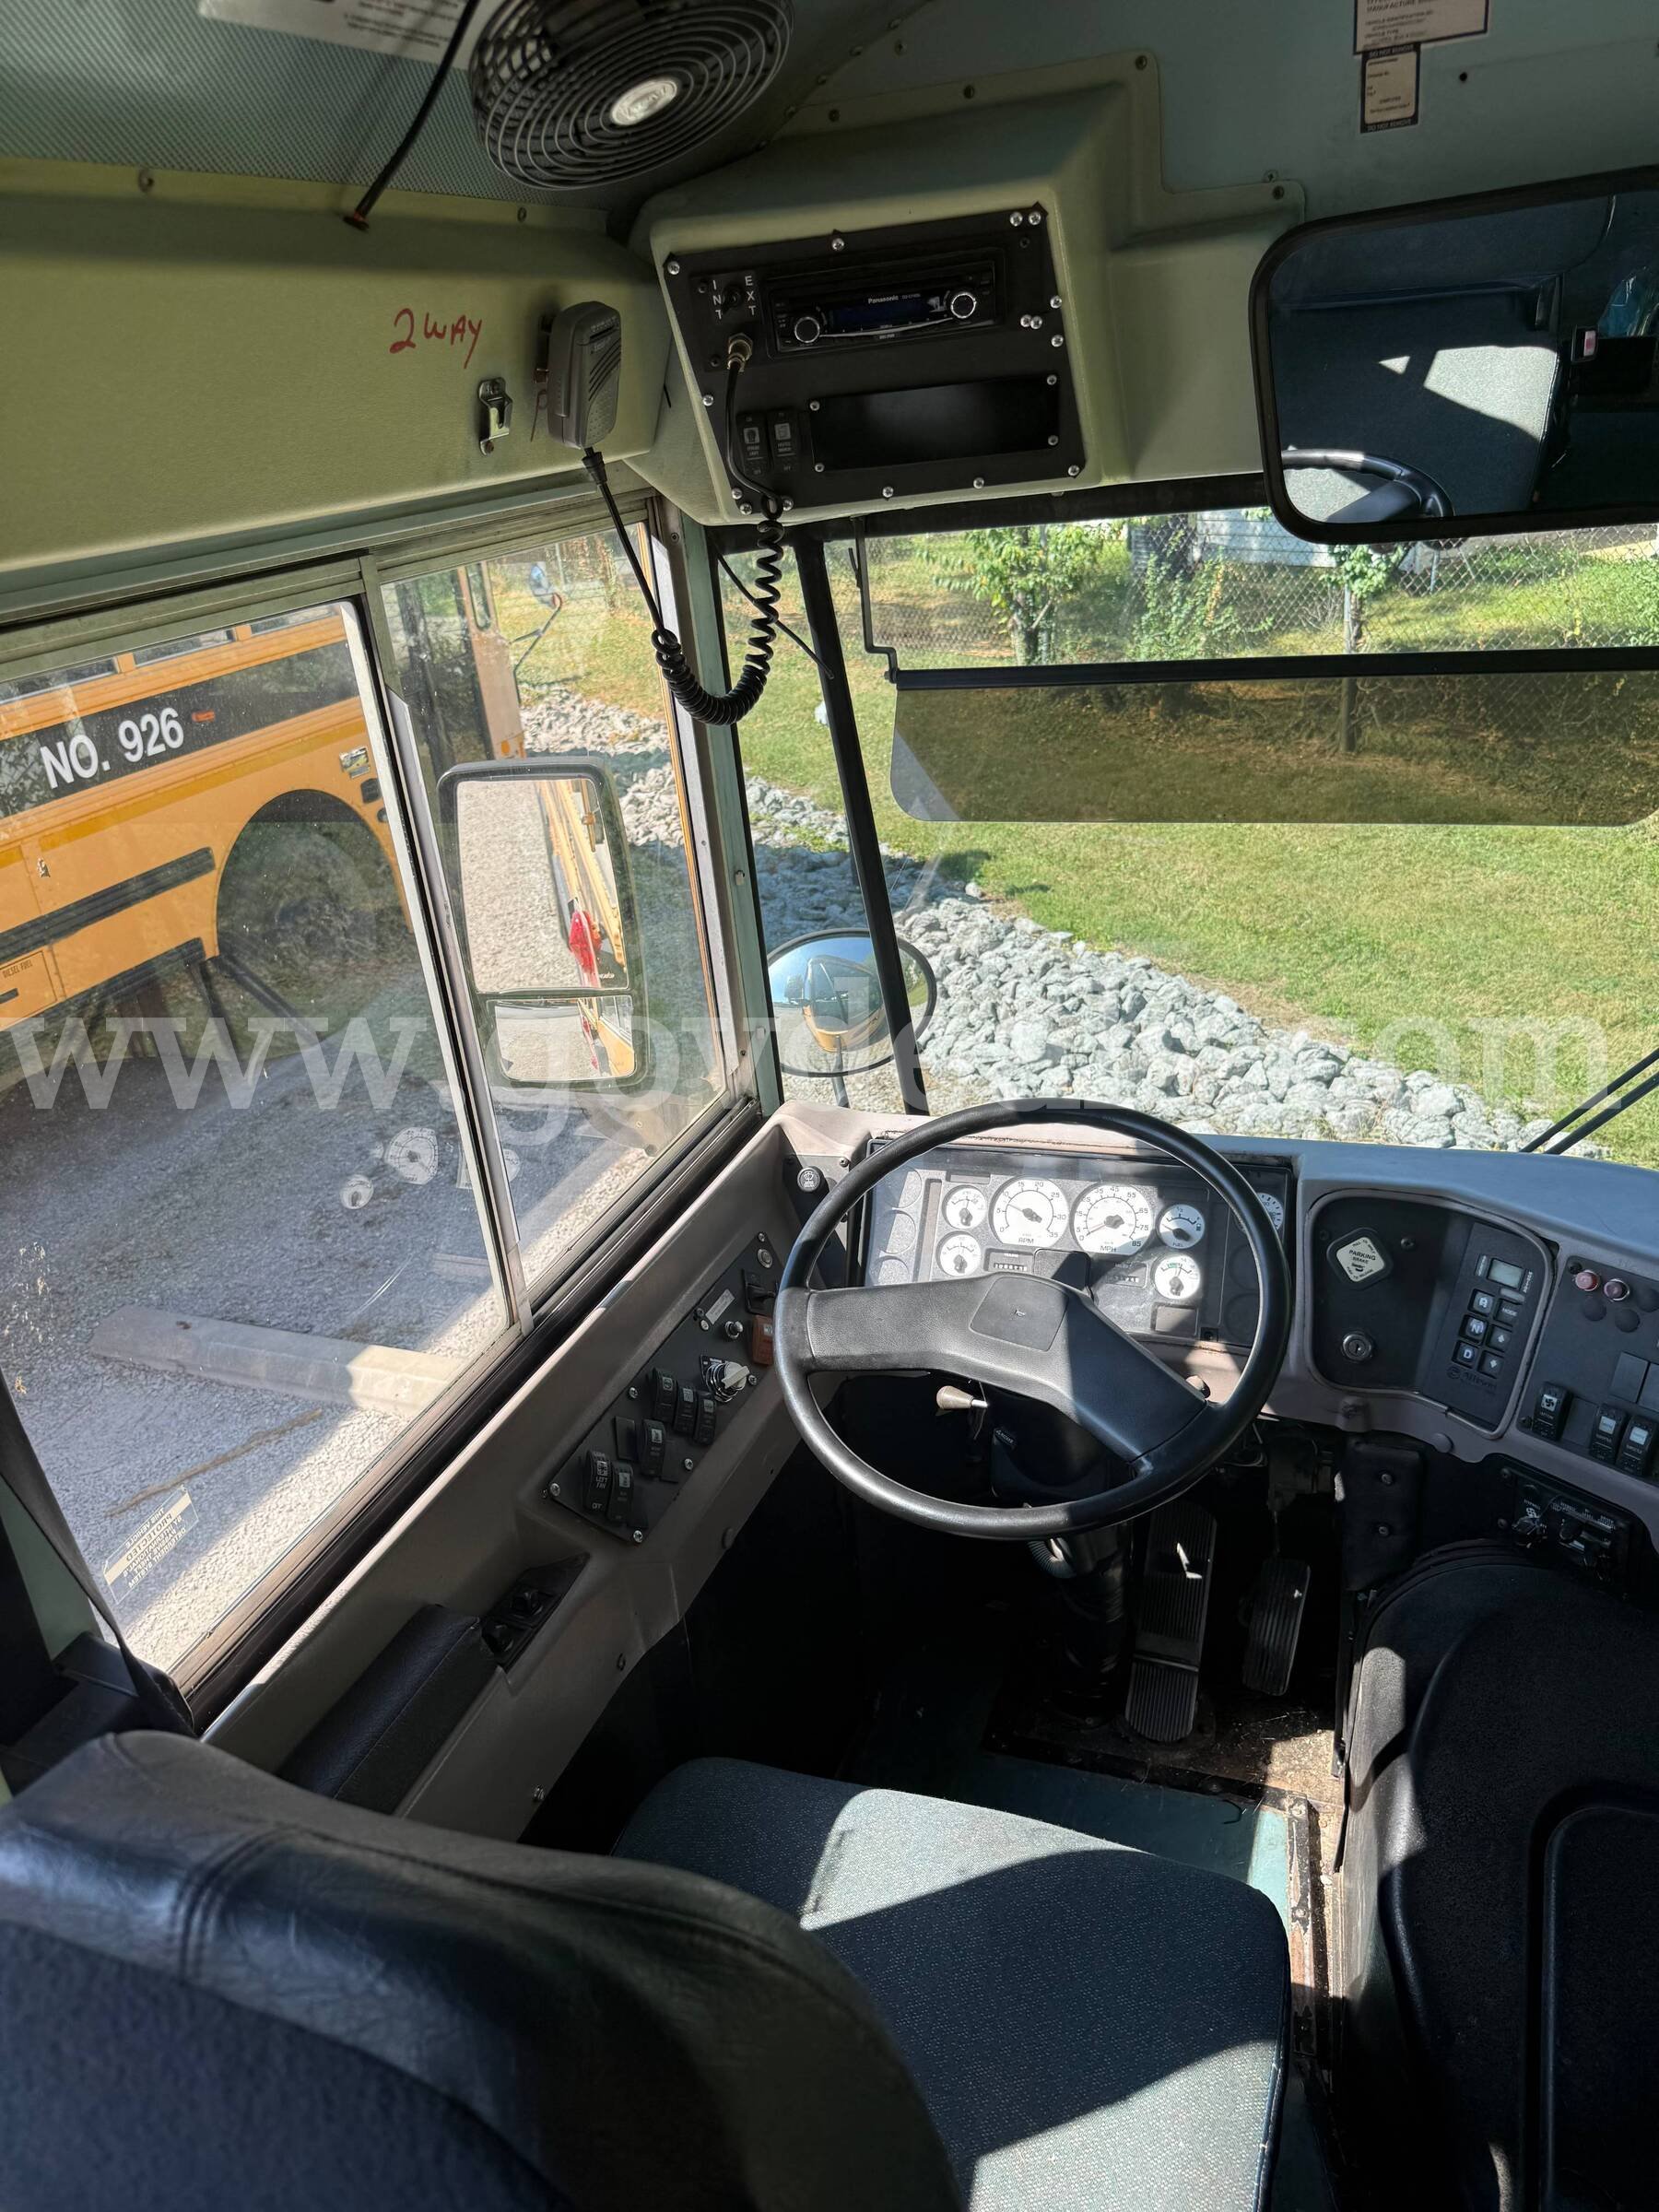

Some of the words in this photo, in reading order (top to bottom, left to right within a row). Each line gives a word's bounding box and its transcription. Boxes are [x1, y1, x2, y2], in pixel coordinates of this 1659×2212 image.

[867, 295, 900, 304] Panasonic
[389, 308, 417, 354] 2
[424, 312, 482, 370] WAY
[40, 735, 111, 789] NO.
[118, 707, 184, 762] 926
[1348, 1249, 1376, 1261] PARKING
[1463, 1349, 1472, 1359] D
